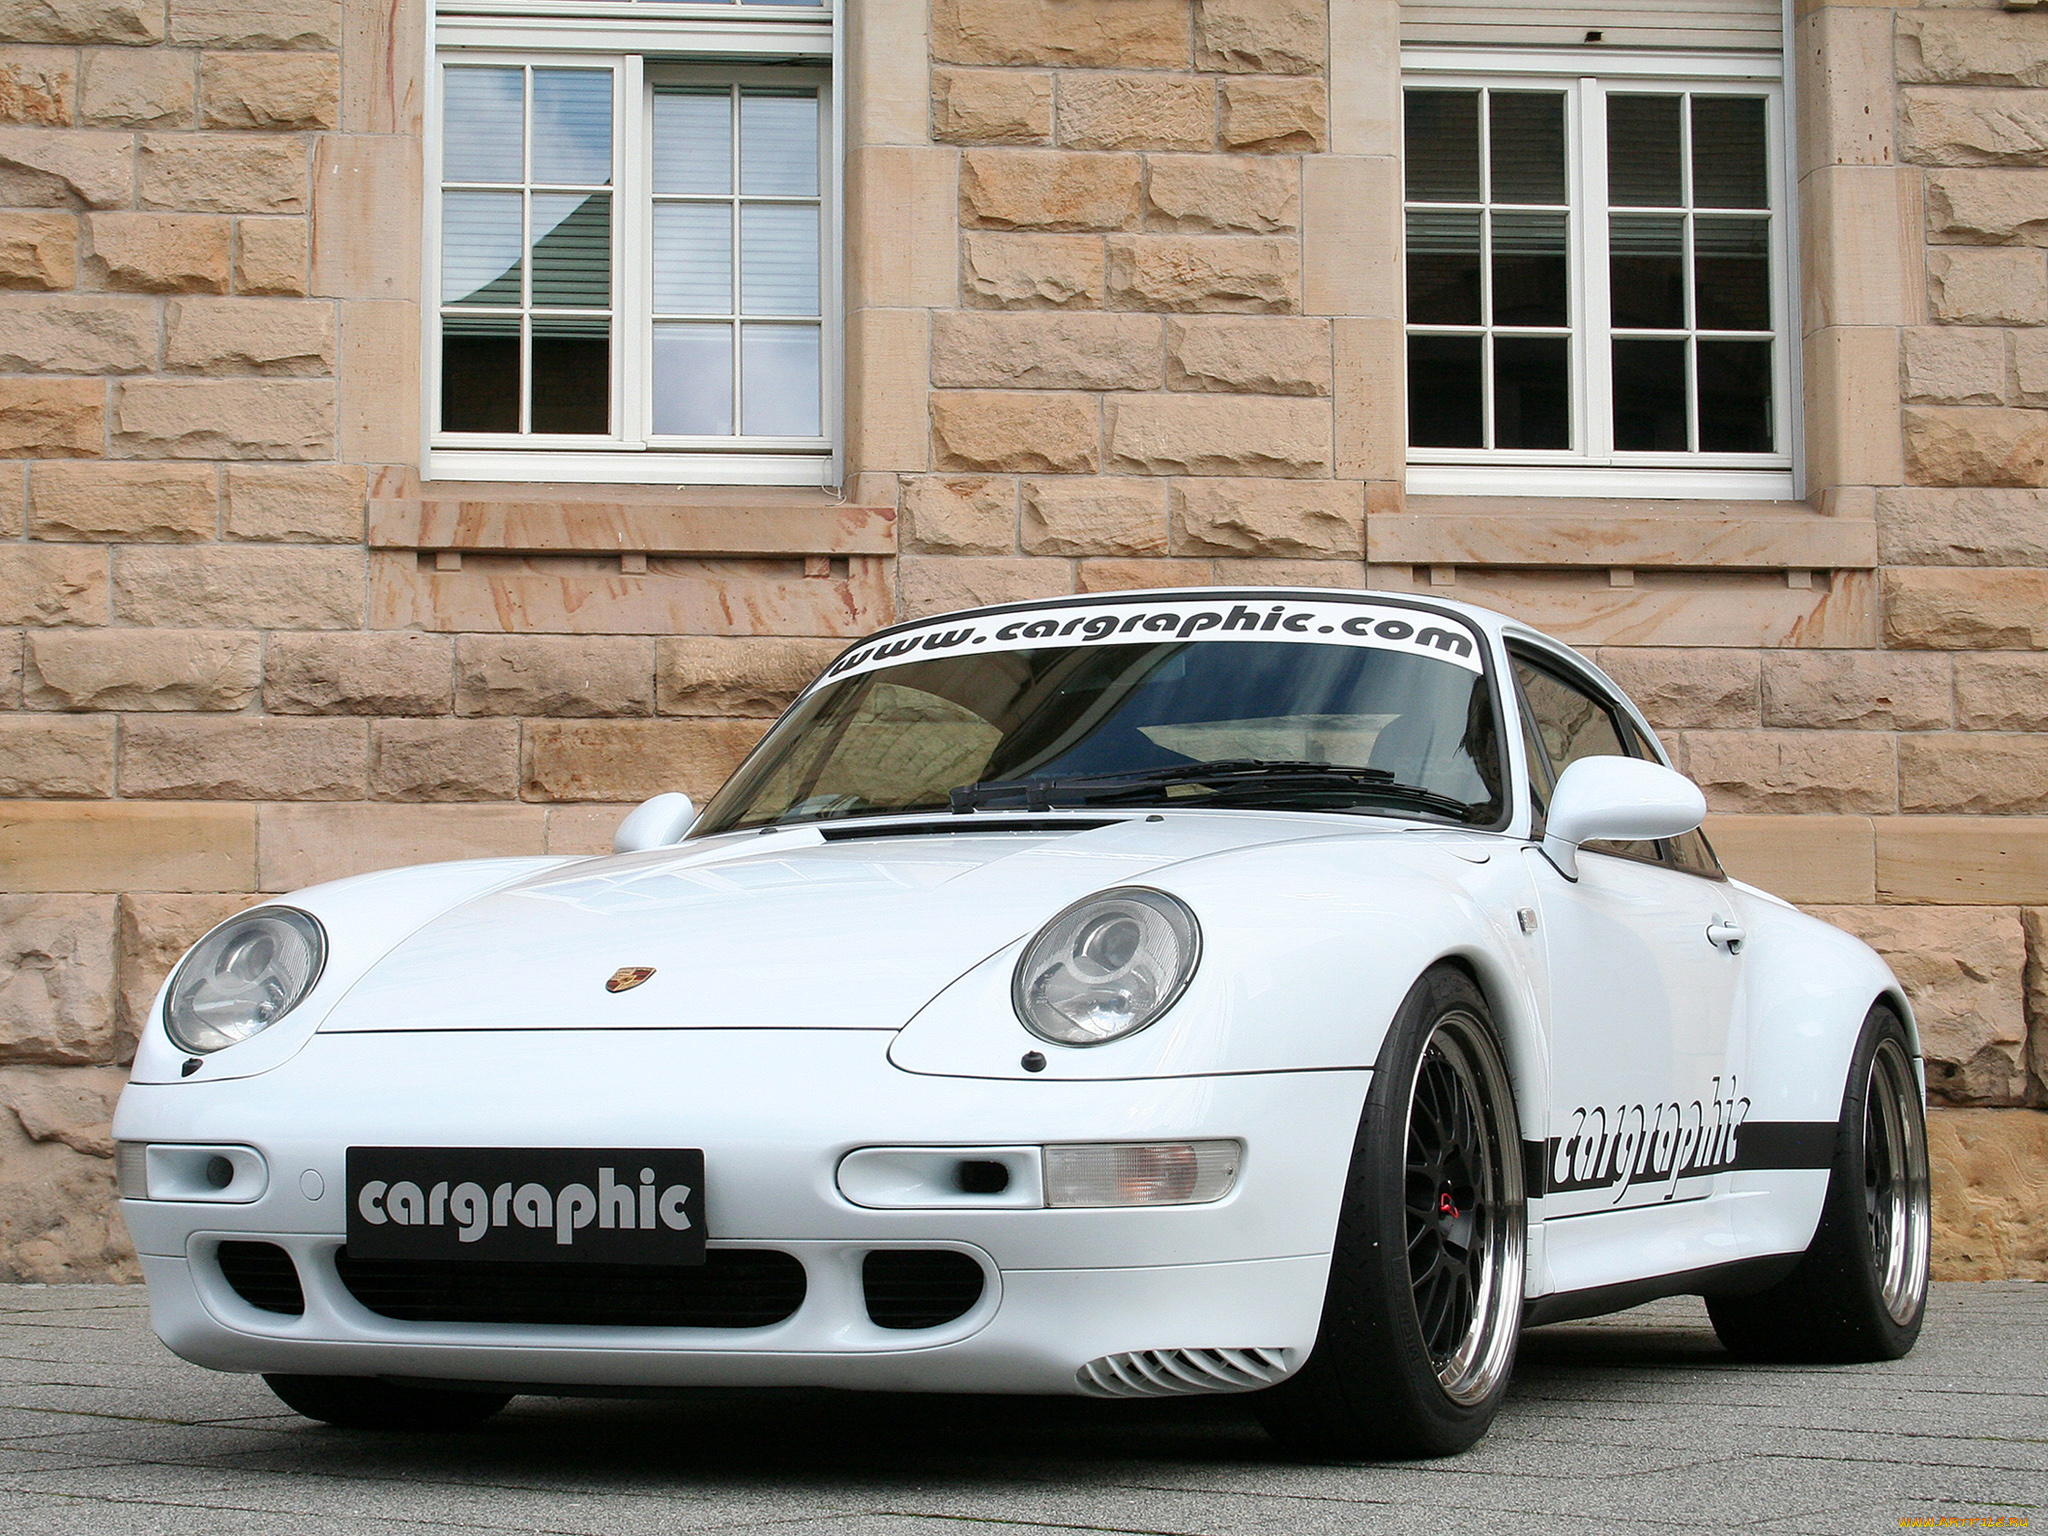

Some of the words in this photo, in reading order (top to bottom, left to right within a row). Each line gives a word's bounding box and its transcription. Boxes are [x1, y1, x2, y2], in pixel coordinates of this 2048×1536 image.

[828, 606, 1473, 677] www.cargraphic.com
[1554, 1074, 1751, 1204] cargraphic
[358, 1167, 692, 1245] cargraphic
